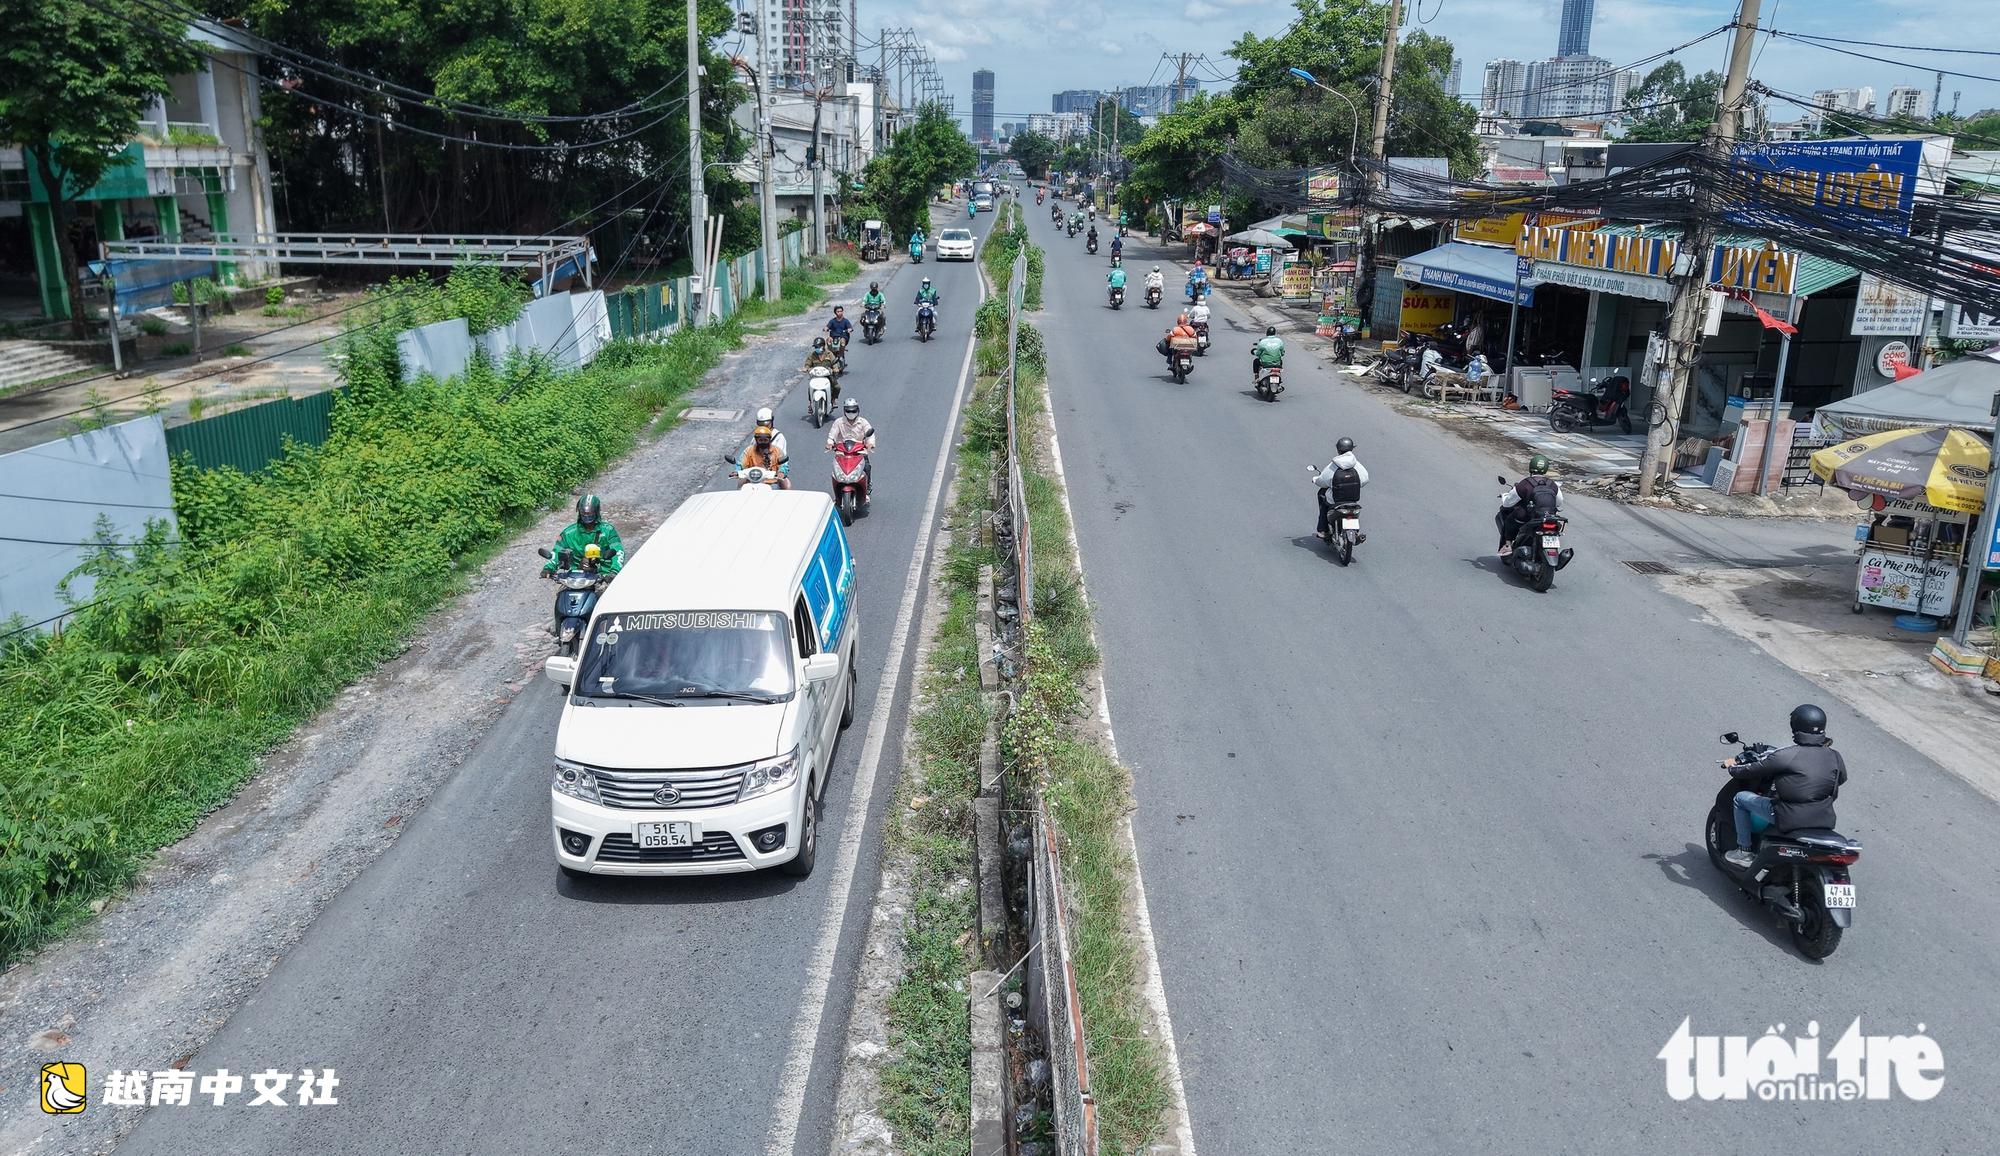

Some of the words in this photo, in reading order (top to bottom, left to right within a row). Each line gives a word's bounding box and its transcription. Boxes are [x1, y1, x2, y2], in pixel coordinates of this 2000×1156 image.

[1829, 146, 1853, 156] TRANG
[1854, 144, 1867, 155] TRÍ
[1867, 145, 1882, 158] NỘI
[1882, 143, 1903, 156] THẤT
[1518, 258, 1529, 270] 367
[1568, 231, 1609, 269] MEN
[1615, 224, 1653, 276] HẢI
[1722, 240, 1797, 294] UYÊN
[1298, 268, 1310, 276] CANH
[1423, 269, 1442, 282] THANH
[1403, 295, 1430, 309] SỬA
[1433, 297, 1451, 309] XE
[1883, 351, 1906, 360] CÔNG
[1841, 416, 1864, 431] NEM
[1883, 559, 1904, 572] Phê
[1904, 562, 1923, 574] Pha
[626, 613, 756, 630] MITSUBISHI
[653, 823, 677, 834] 51E
[645, 834, 687, 846] 058.54
[1829, 886, 1851, 896] 47-AA
